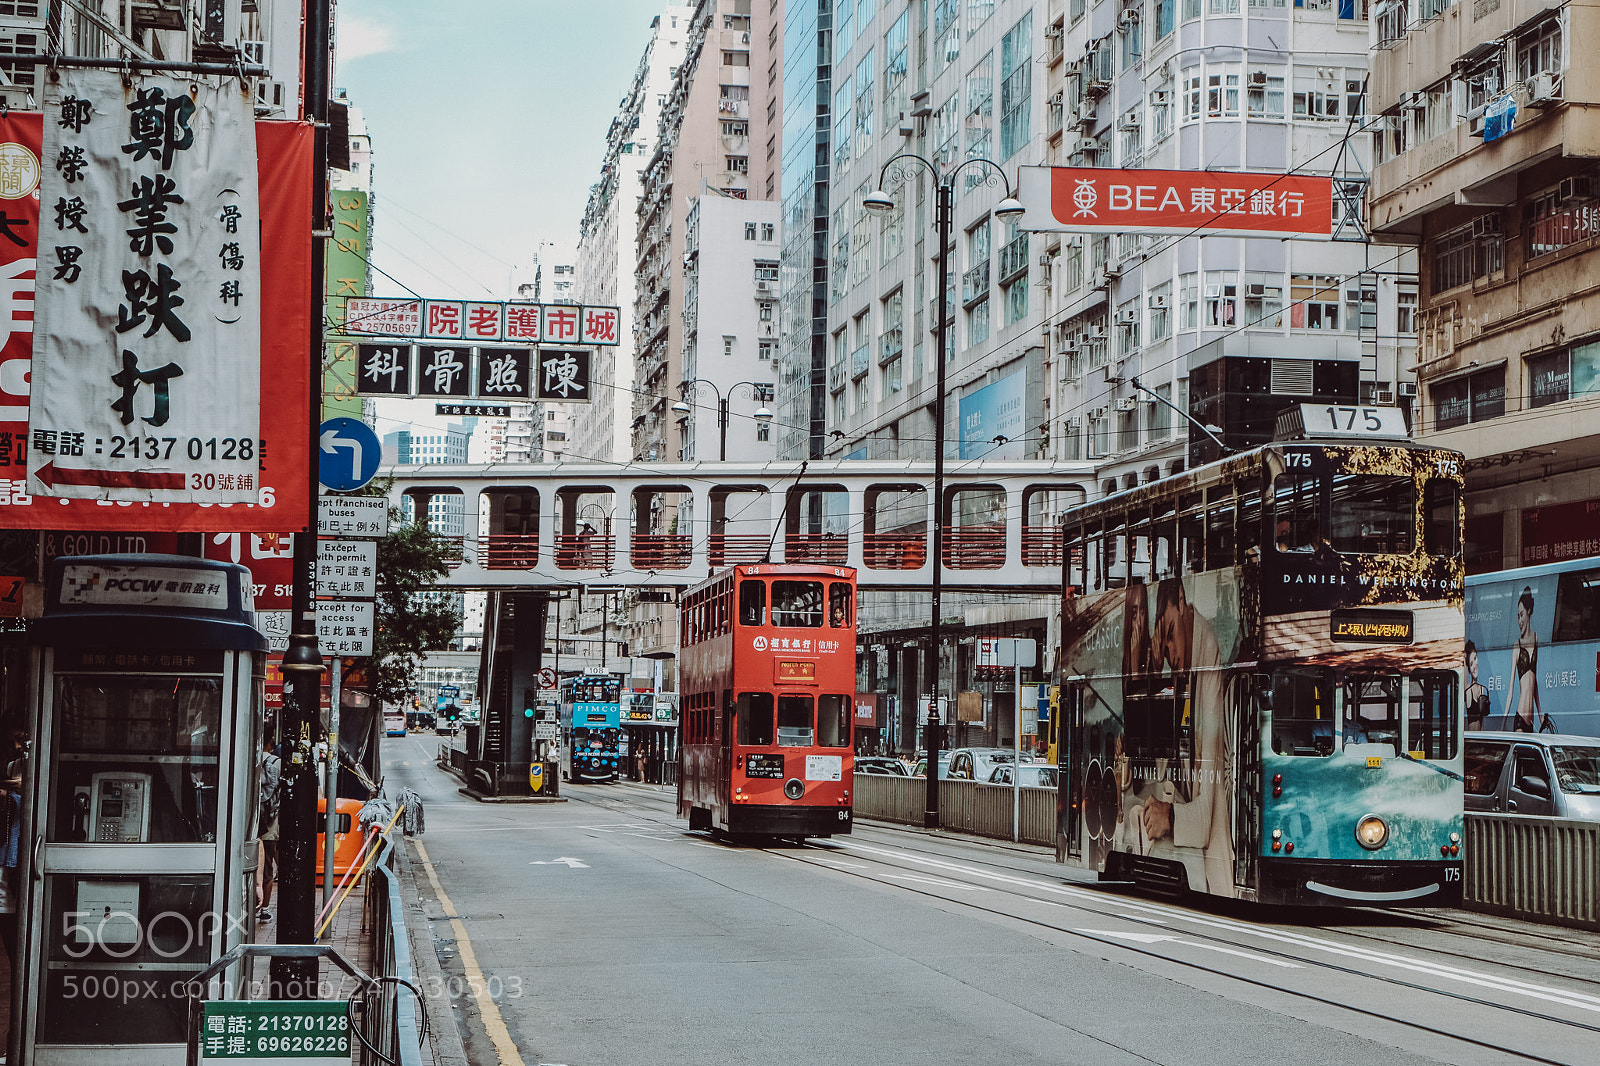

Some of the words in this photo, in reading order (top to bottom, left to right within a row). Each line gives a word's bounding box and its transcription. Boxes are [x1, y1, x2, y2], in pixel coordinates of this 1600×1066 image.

[1109, 184, 1185, 213] BEA
[1190, 187, 1305, 217] 東亞銀行
[338, 196, 362, 253] 375
[110, 86, 196, 428] 鄭業跌打
[366, 322, 418, 334] 25705697
[1326, 406, 1382, 432] 175
[110, 435, 177, 460] 2137
[187, 437, 254, 461] 0128
[1283, 453, 1312, 468] 175
[1436, 460, 1458, 474] 175
[335, 498, 384, 509] franchised
[328, 508, 355, 517] buses
[324, 543, 357, 554] Except
[336, 553, 367, 564] permit
[317, 565, 372, 577] 許可證者
[747, 566, 760, 575] 84
[834, 568, 846, 577] 84
[104, 578, 163, 593] PCCW
[165, 581, 220, 596] 電訊盈科
[1283, 574, 1347, 585] DANIEL
[1358, 576, 1458, 590] WELLINGTON
[316, 602, 346, 614] xcept
[350, 602, 365, 612] for
[321, 614, 355, 623] access
[317, 625, 370, 638] 往此區者
[1085, 625, 1120, 651] CLASSIC
[577, 705, 618, 713] PIMCO
[1133, 766, 1161, 781] DANIEL
[1166, 767, 1221, 785] WELLINGTON
[838, 810, 849, 820] 84
[1444, 867, 1460, 882] 175
[207, 1015, 252, 1034] 電話:
[258, 1015, 349, 1031] 21370128
[205, 1036, 251, 1055] 手提:
[257, 1036, 348, 1052] 69626226
